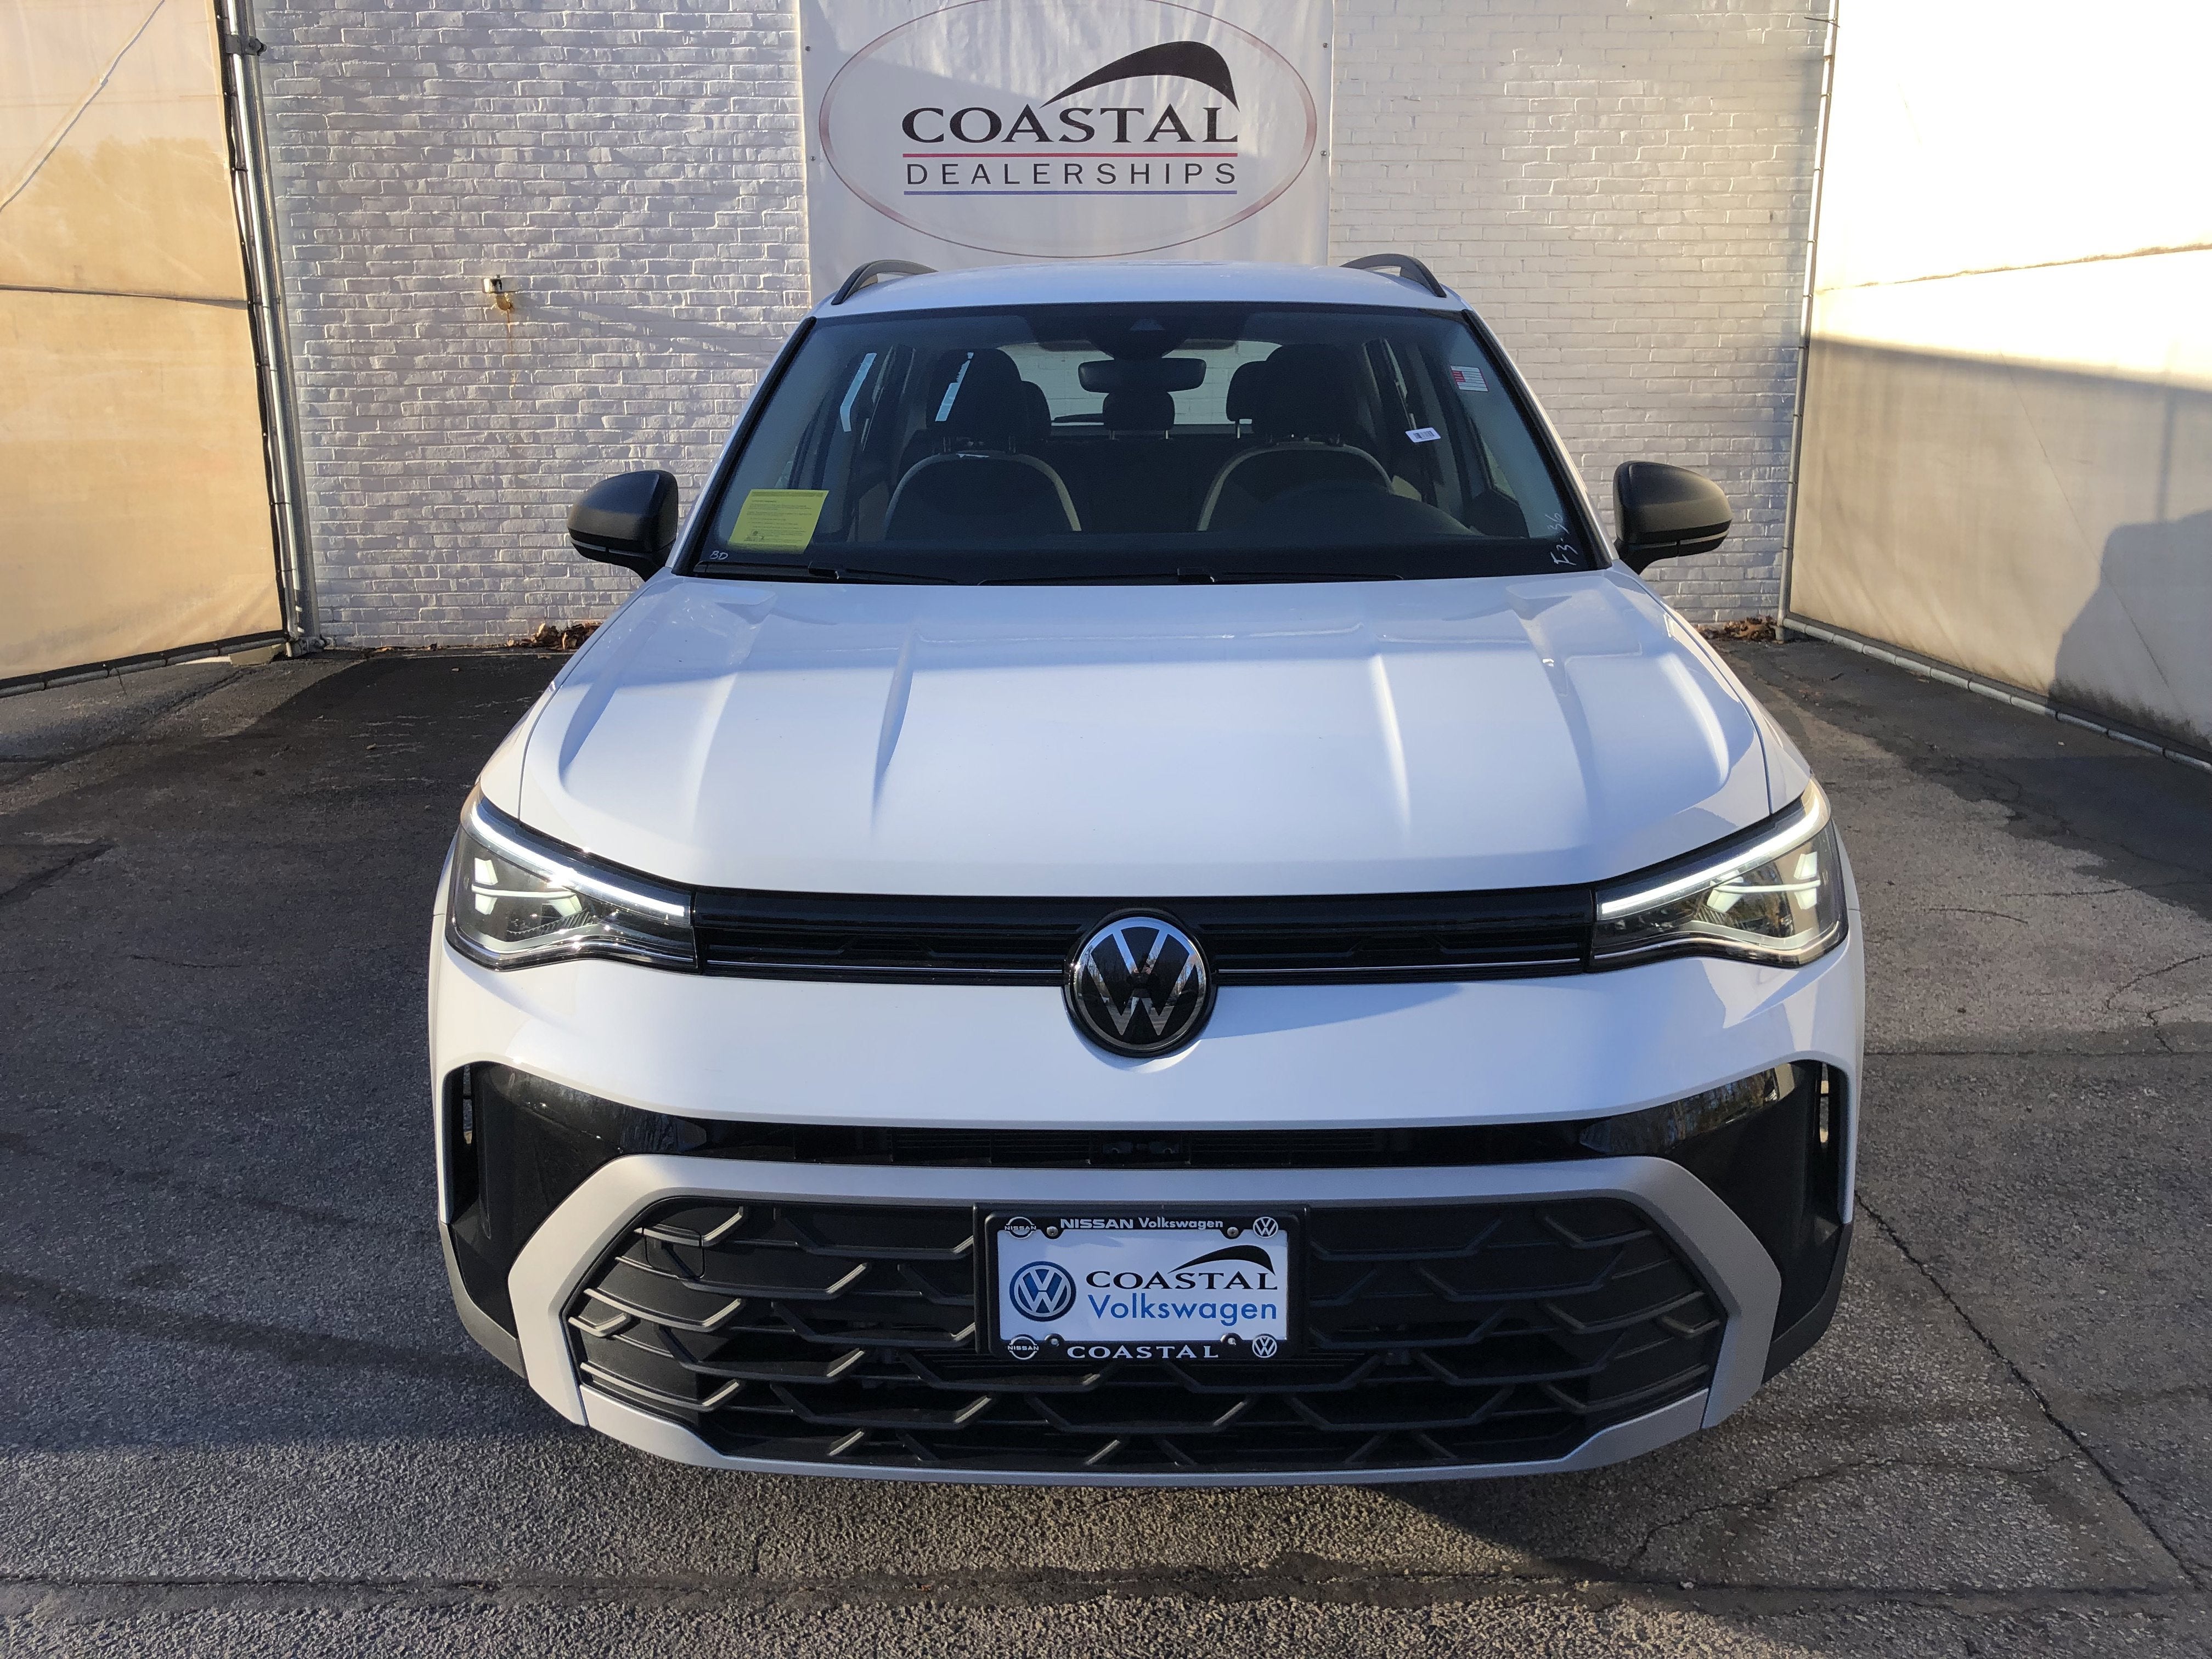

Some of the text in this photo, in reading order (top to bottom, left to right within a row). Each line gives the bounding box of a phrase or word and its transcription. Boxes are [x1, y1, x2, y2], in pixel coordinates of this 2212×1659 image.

[901, 103, 1238, 144] COASTAL
[906, 162, 1236, 185] DEALERSHIPS
[1060, 1217, 1223, 1230] NISSAN Volkswagen
[1086, 1271, 1278, 1290] COASTAL
[1088, 1293, 1277, 1326] Volkswagen
[1067, 1345, 1218, 1359] COASTAL
